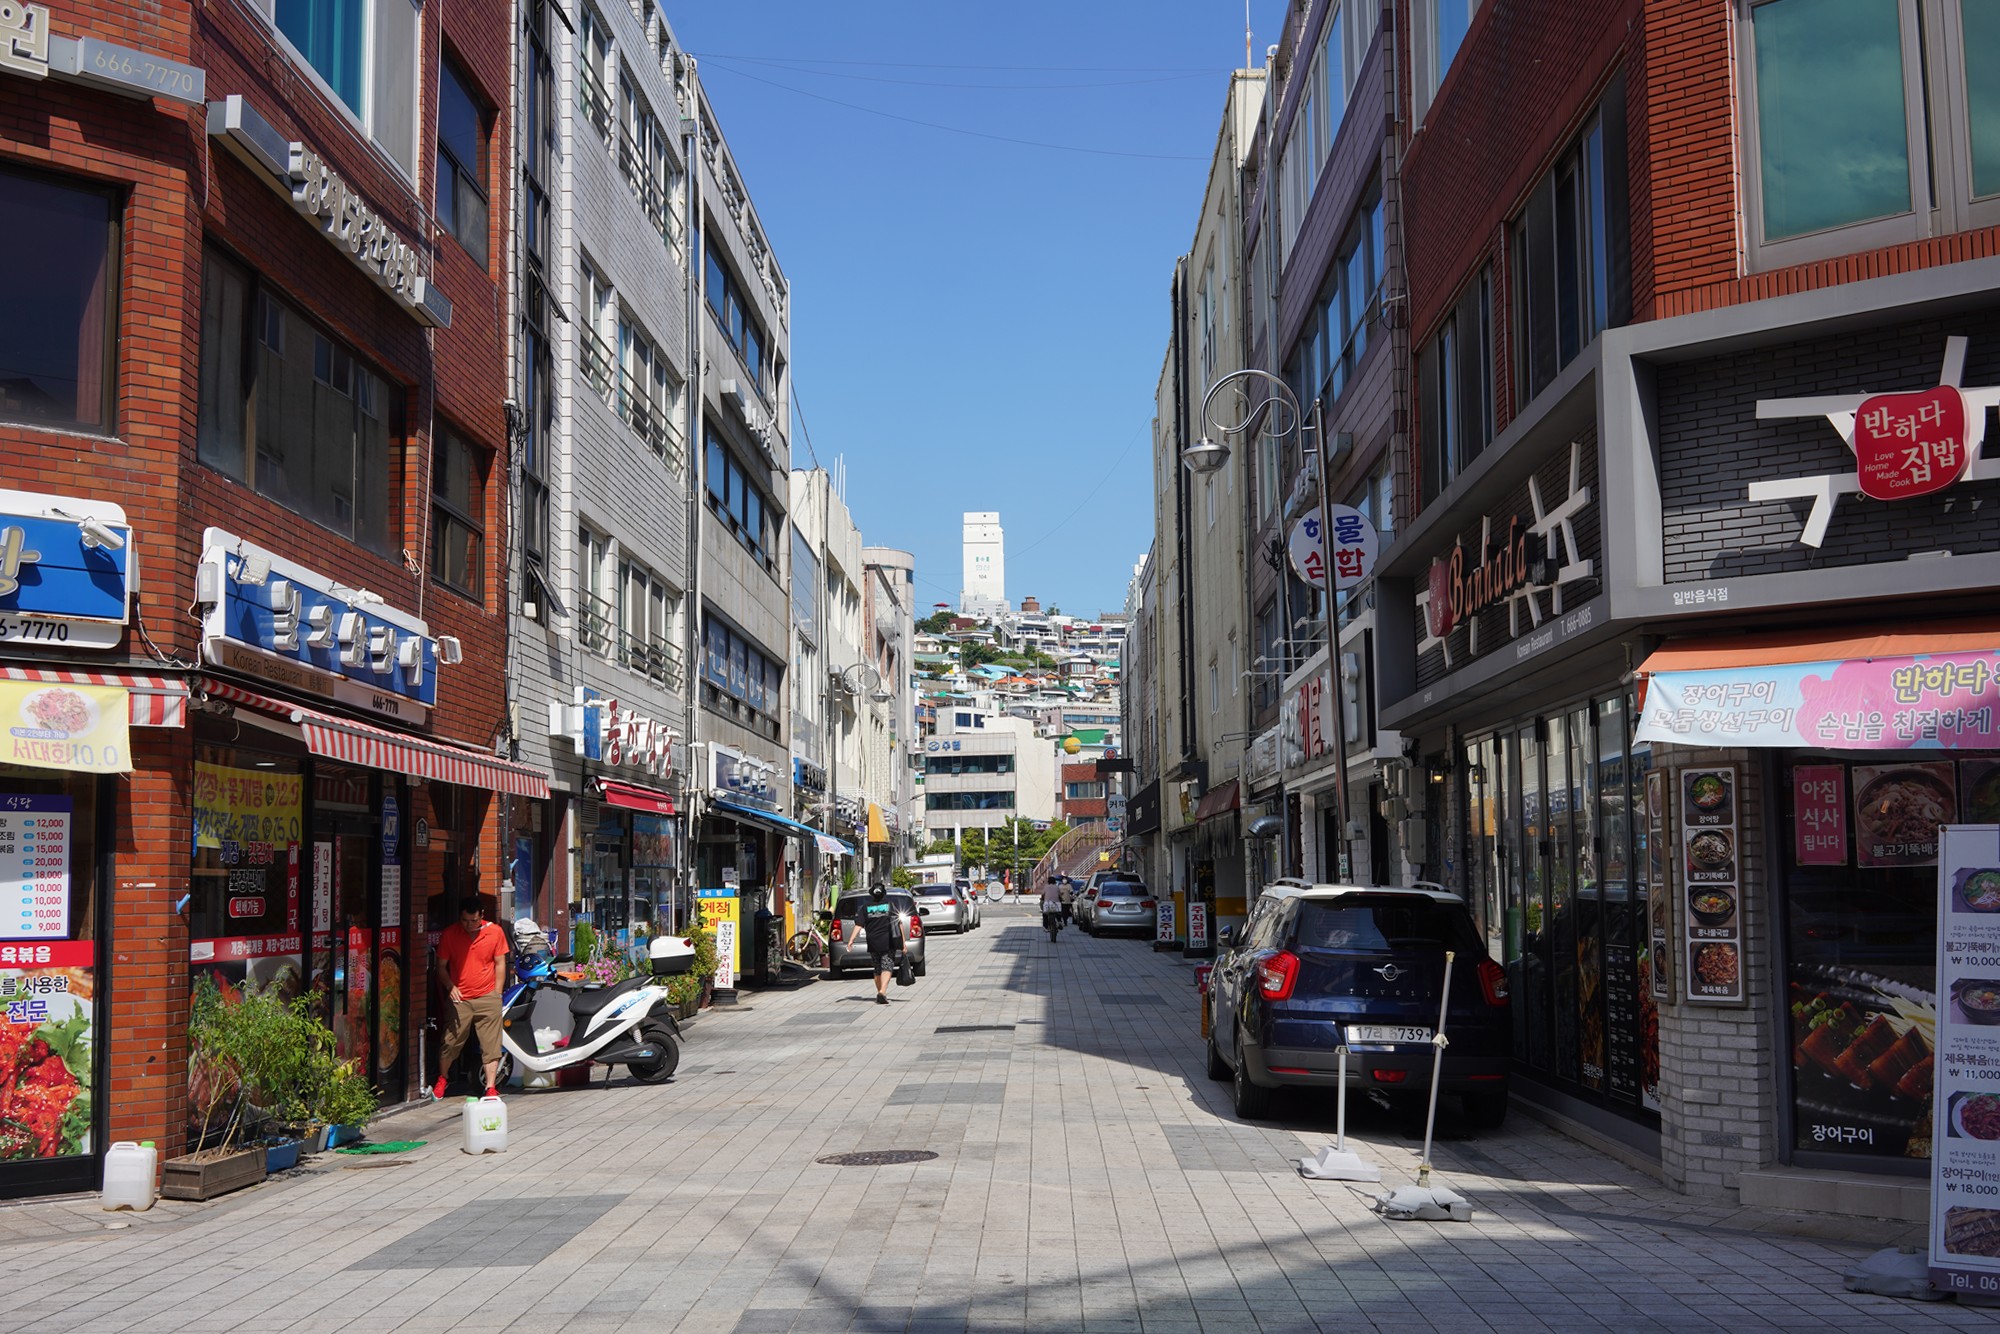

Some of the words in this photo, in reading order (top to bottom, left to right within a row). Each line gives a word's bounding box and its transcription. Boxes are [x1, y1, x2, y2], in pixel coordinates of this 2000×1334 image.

[95, 50, 193, 93] 666-7770
[1862, 399, 1945, 440] 반하다
[1874, 452, 1895, 461] Love
[1901, 438, 1959, 483] 집밥
[1865, 462, 1889, 472] Home
[1876, 470, 1899, 480] Made
[1889, 478, 1911, 488] Cook
[1450, 514, 1527, 624] Banhada
[1673, 588, 1728, 605] 일반음식점
[233, 650, 262, 675] Korean
[263, 658, 303, 684] Restaurant
[1892, 659, 1989, 703] 반하다
[1682, 681, 1776, 708] 장어구이
[372, 694, 399, 715] 666-7770
[1650, 707, 1793, 733] 모둠생선구이
[1817, 712, 1885, 739] 손님을
[1893, 708, 1991, 739] 친절하게
[13, 739, 70, 765] 서대회
[1801, 781, 1838, 804] 아침
[7, 796, 32, 809] 식당
[36, 818, 64, 829] 12,000
[1802, 808, 1839, 831] 식사
[36, 831, 64, 841] 15,000
[1803, 834, 1840, 852] 됩니다
[36, 844, 63, 854] 15,000
[35, 857, 63, 867] 20,000
[35, 870, 63, 880] 18,000
[35, 883, 62, 893] 10,000
[34, 896, 62, 906] 10,000
[704, 901, 728, 914] 게장
[34, 909, 61, 919] 10,000
[1190, 905, 1205, 940] 주차금지
[38, 922, 61, 932] 9,000
[1, 945, 51, 963] 육볶음
[22, 976, 68, 994] 사용한
[8, 1000, 48, 1023] 전문
[1965, 1070, 2000, 1080] 11,000
[1812, 1124, 1874, 1145] 장어구이
[1961, 1185, 1998, 1196] 18,000
[1948, 1272, 1974, 1289] Tel.
[1980, 1275, 2000, 1291] 06
